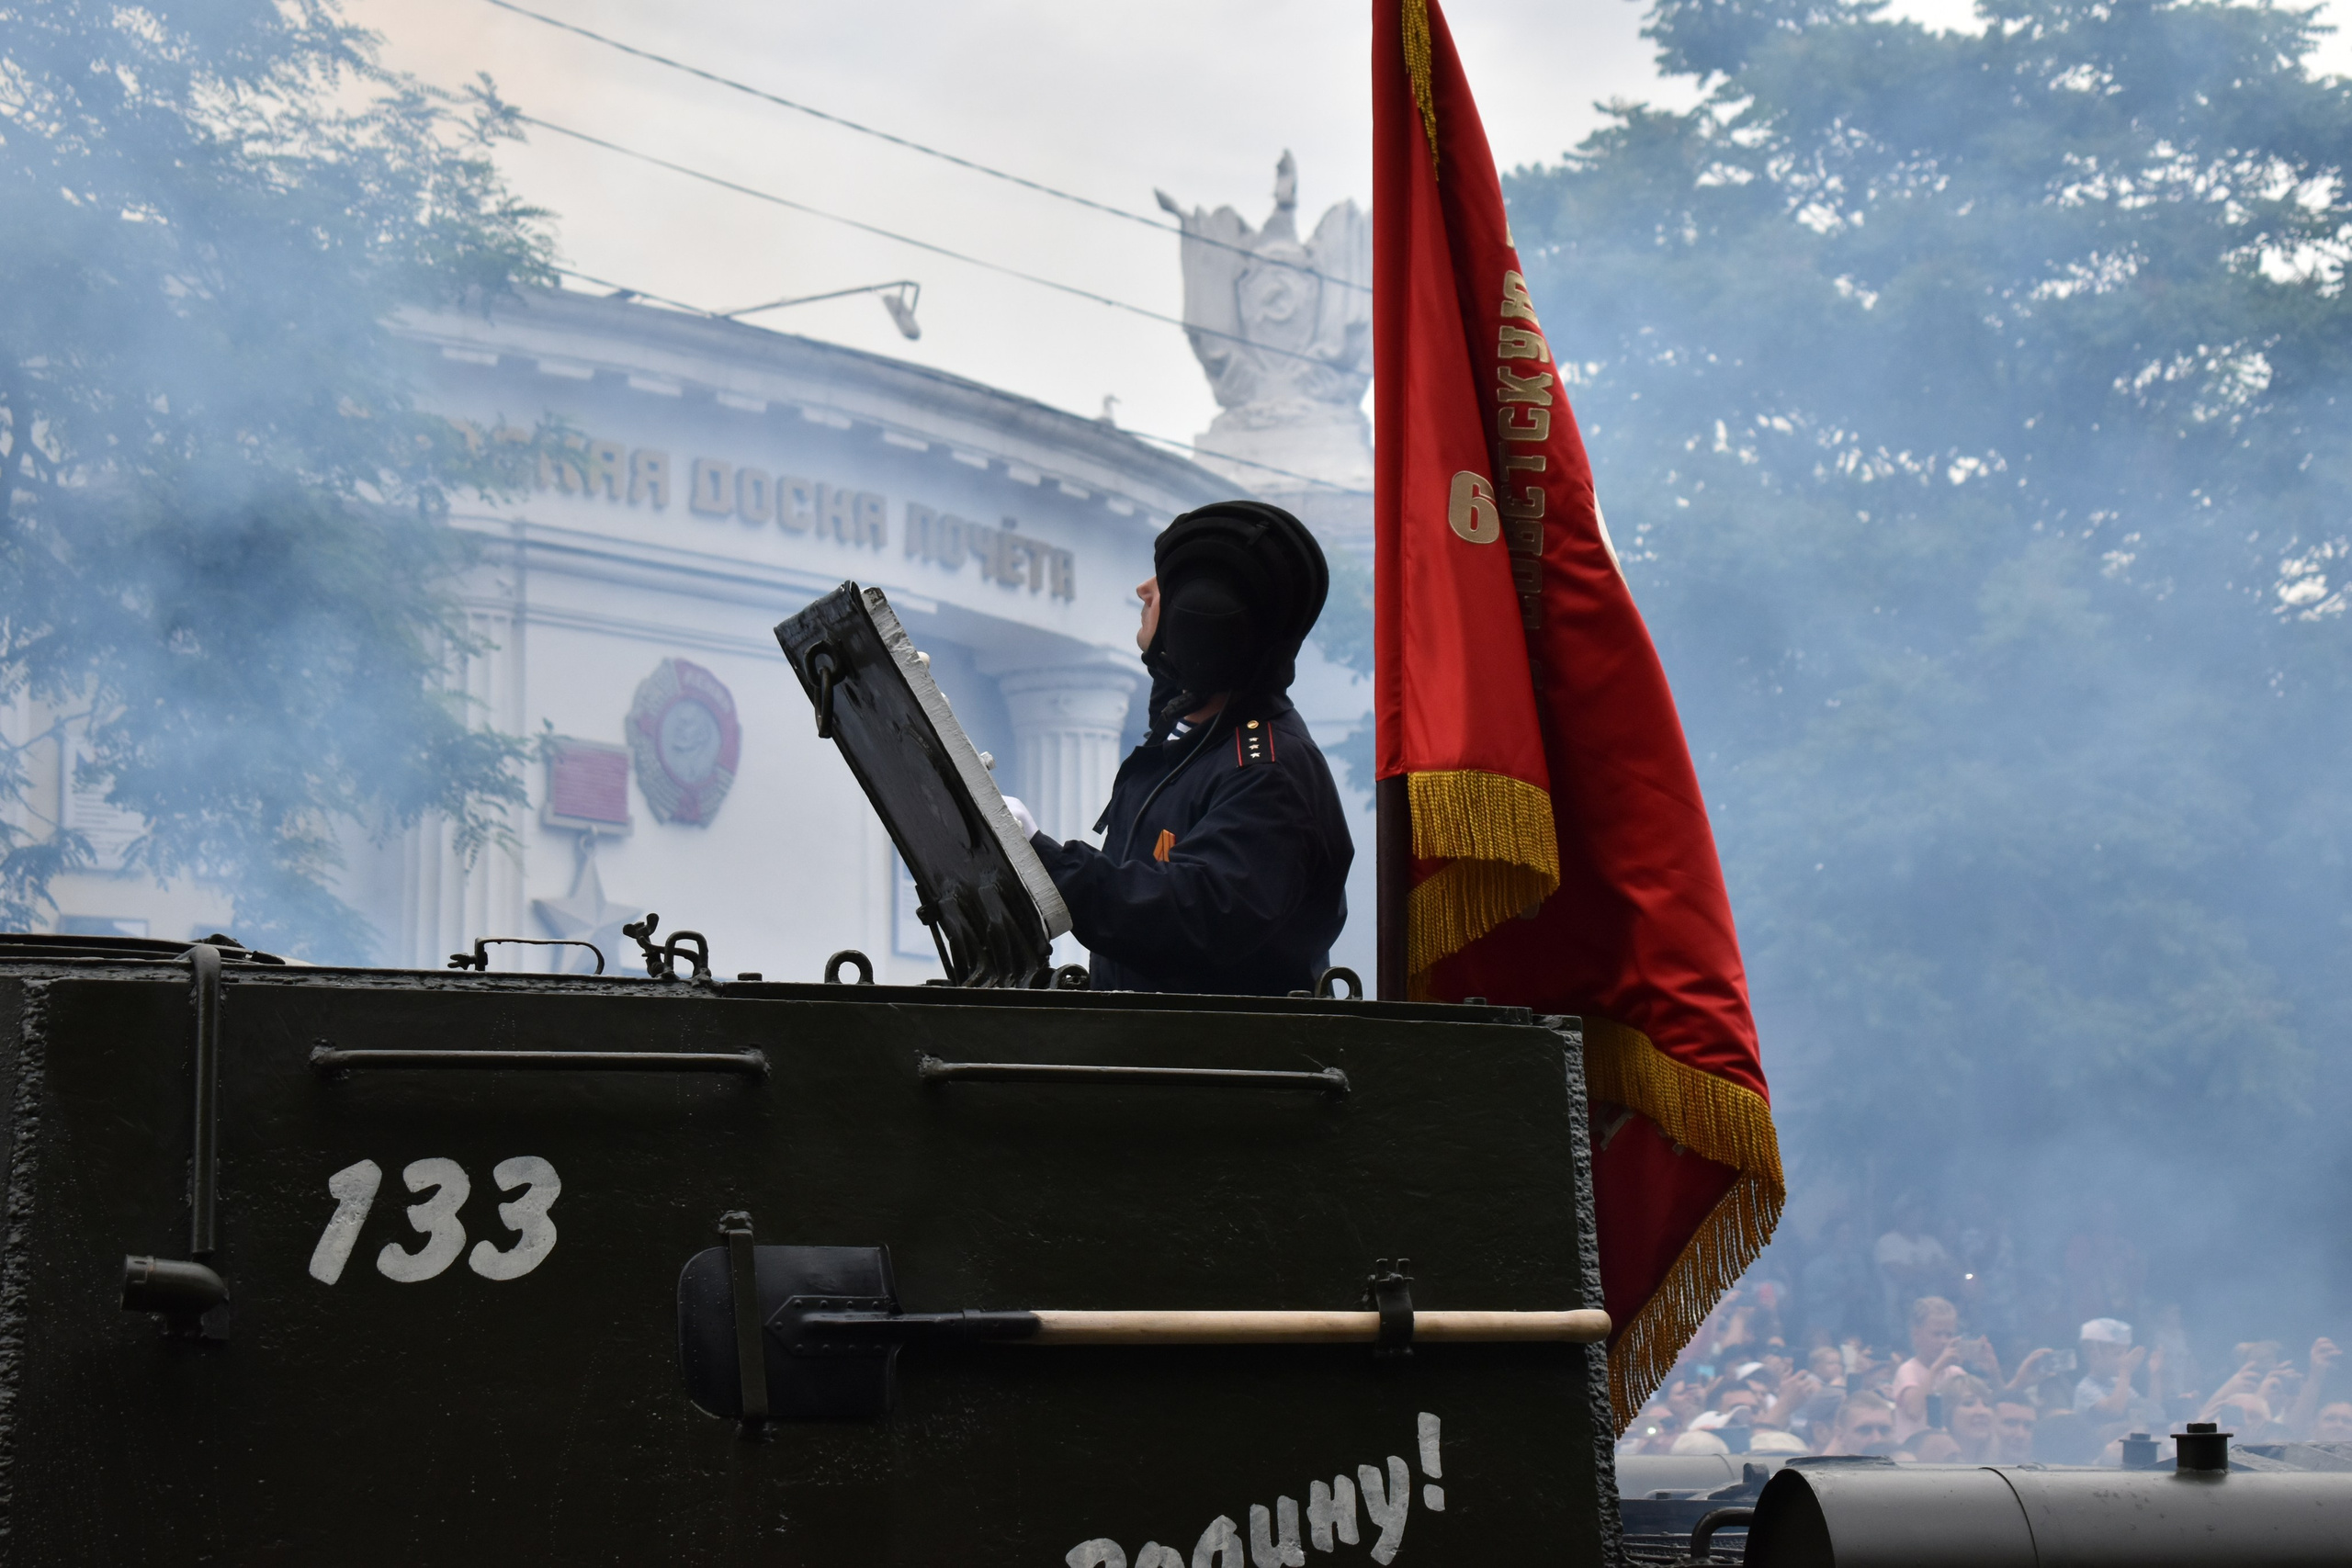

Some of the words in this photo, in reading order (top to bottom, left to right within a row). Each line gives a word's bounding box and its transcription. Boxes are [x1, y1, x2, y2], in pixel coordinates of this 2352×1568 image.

[690, 457, 888, 554] ДОСКА
[905, 502, 1076, 604] ПОЧЁТА
[1449, 469, 1500, 544] 6
[309, 1156, 562, 1285] 133
